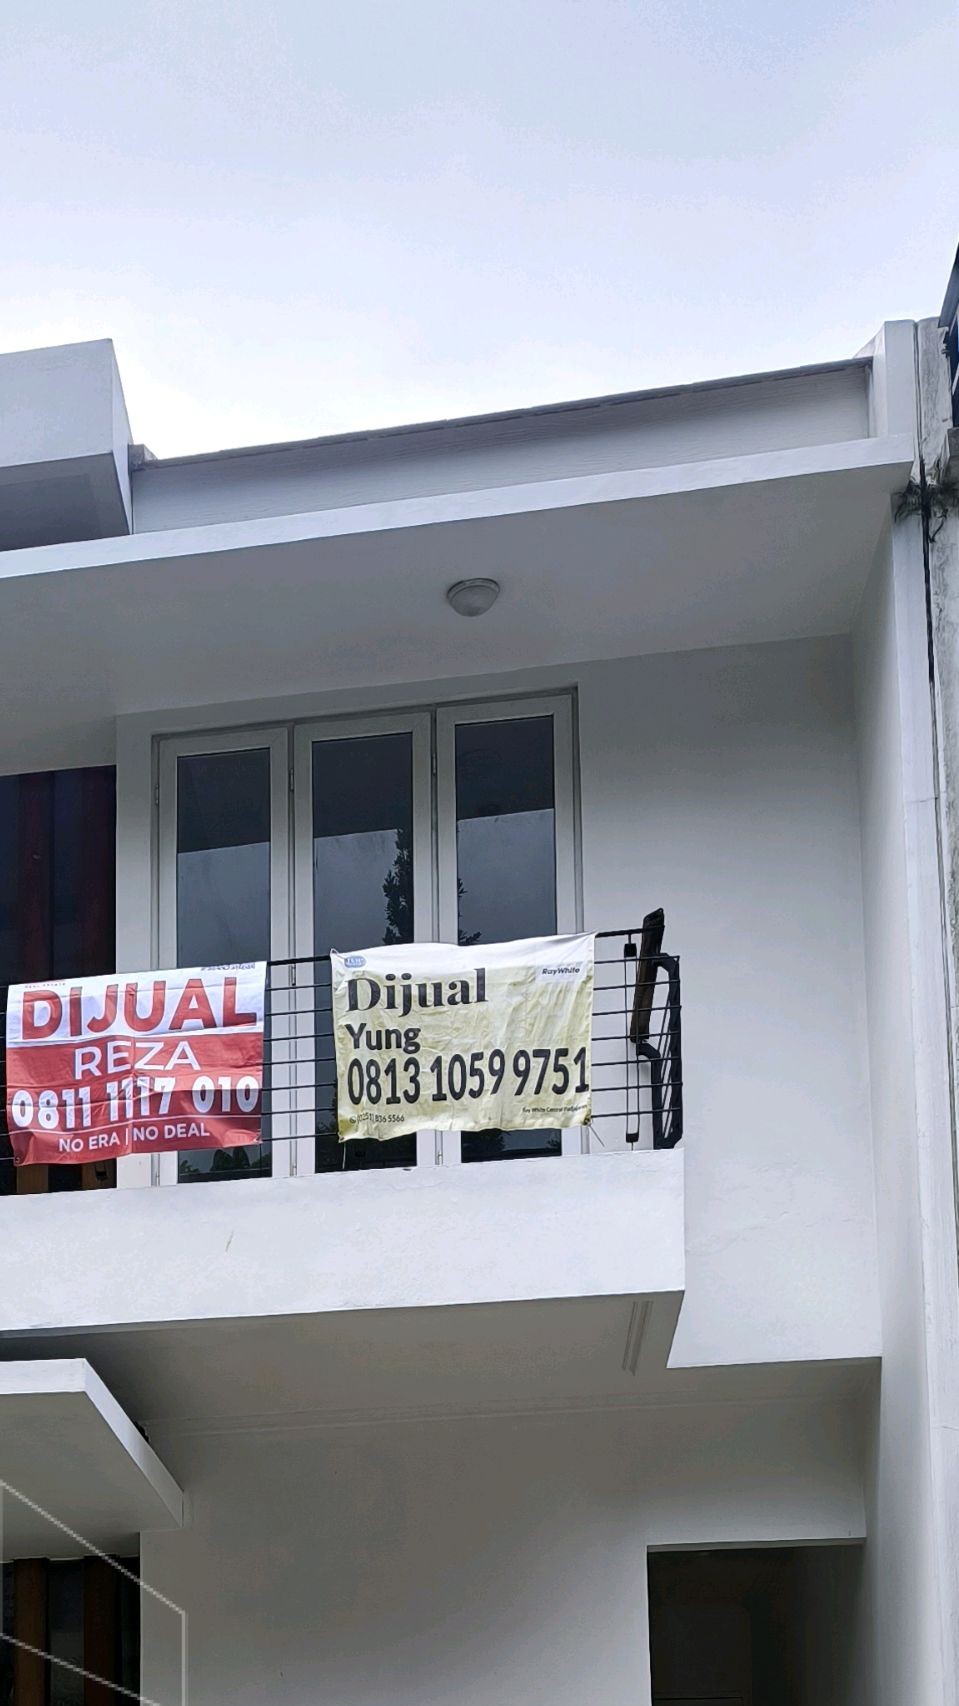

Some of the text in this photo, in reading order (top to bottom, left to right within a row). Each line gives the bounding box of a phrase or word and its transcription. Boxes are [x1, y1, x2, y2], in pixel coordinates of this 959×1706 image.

[22, 977, 257, 1039] DIJUAL
[345, 967, 489, 1018] Dijual
[74, 1040, 202, 1081] REZA
[345, 1022, 422, 1055] Yung
[347, 1046, 590, 1105] 0813 1059 9751
[11, 1075, 260, 1130] 0811 1117 010
[58, 1122, 210, 1152] NO ERA NO DEAL
